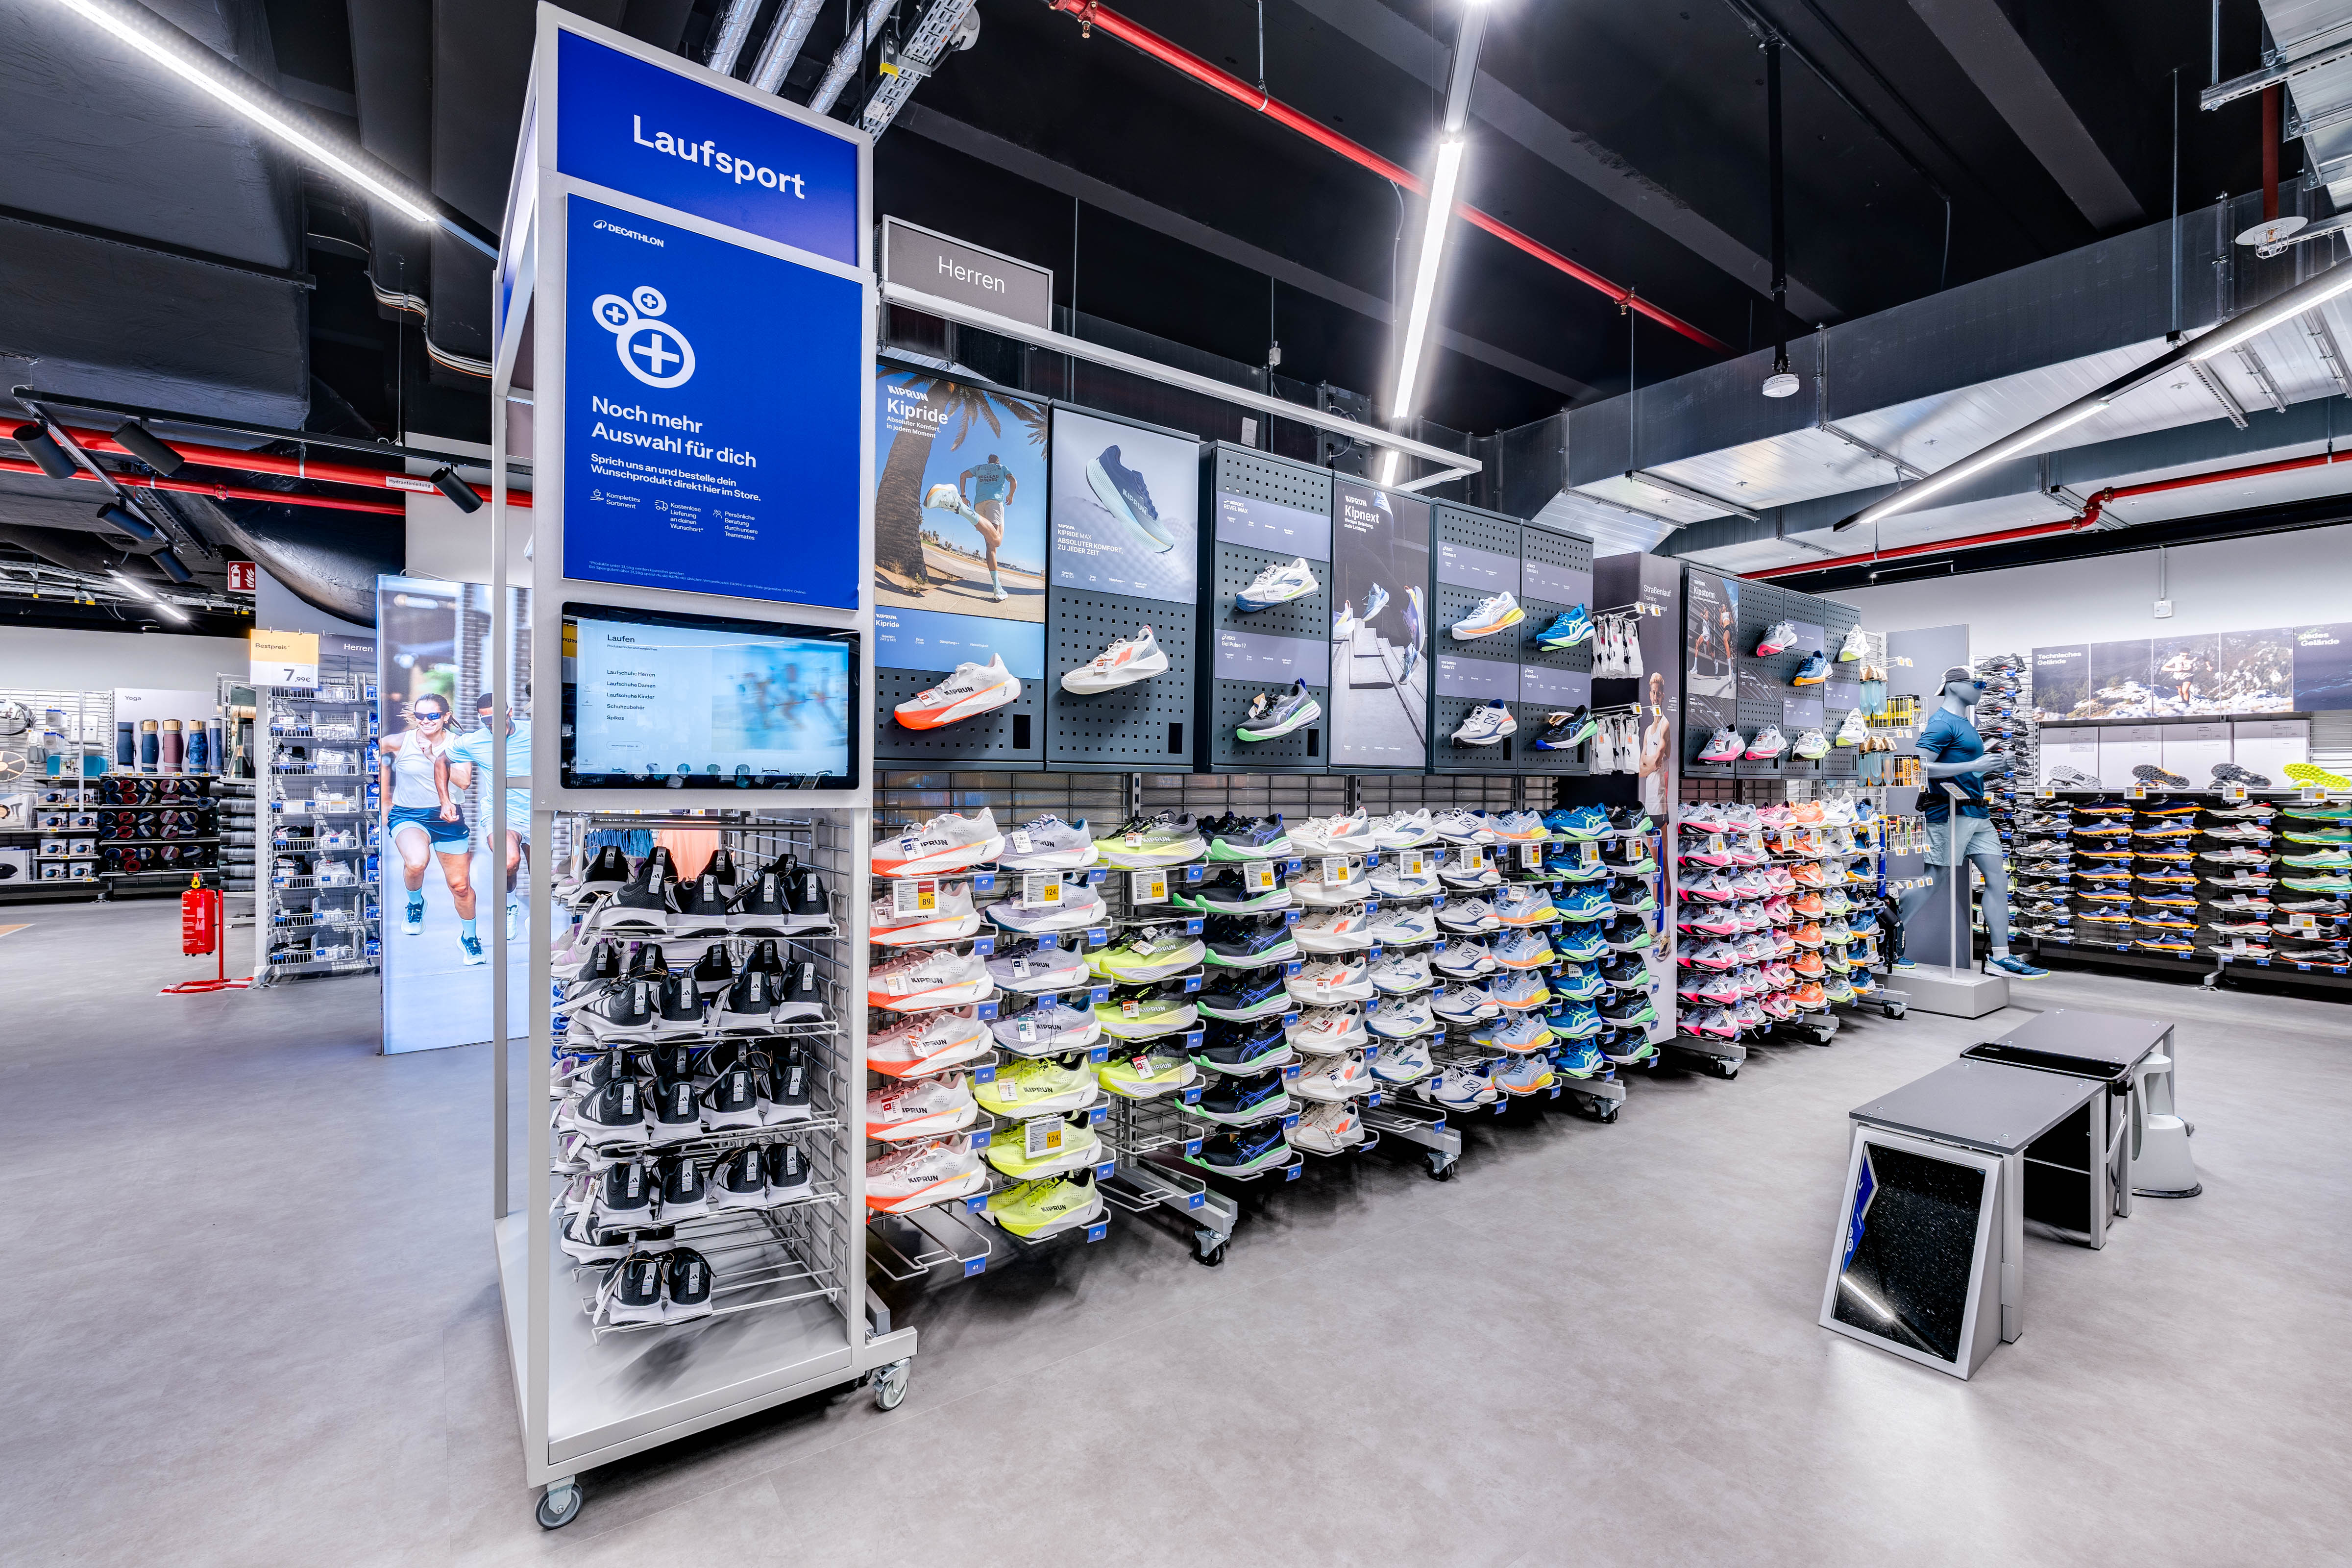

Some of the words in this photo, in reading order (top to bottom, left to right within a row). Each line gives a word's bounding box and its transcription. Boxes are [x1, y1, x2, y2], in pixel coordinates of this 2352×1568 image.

[634, 115, 805, 199] Laufsport
[608, 222, 663, 247] DECATHLON
[939, 256, 1004, 293] Herren
[887, 385, 929, 401] KIPRUN
[593, 396, 647, 422] Noch
[652, 413, 703, 433] mehr
[888, 398, 948, 424] Kipride
[887, 416, 915, 426] Absoluter
[917, 422, 941, 433] Komfort,
[912, 429, 935, 438] Moment
[591, 422, 681, 453] Auswahl
[685, 441, 713, 459] für
[716, 447, 756, 467] dich
[591, 454, 624, 466] Sprich
[659, 468, 677, 476] und
[679, 469, 715, 483] bestelle
[717, 477, 736, 487] dein
[591, 464, 672, 486] Wunschprodukt
[674, 480, 702, 491] direkt
[703, 484, 721, 494] hier
[722, 488, 733, 496] im
[734, 490, 760, 501] Store.
[607, 492, 640, 502] Komplettes
[1123, 488, 1147, 515] KIPRUN
[1345, 495, 1367, 507] KIPRUN
[607, 499, 636, 509] Sortiment
[671, 503, 701, 512] Kostenlose
[671, 510, 696, 519] Lieferung
[725, 511, 755, 520] Persönliche
[1345, 505, 1379, 524] Kipnext
[725, 518, 749, 527] Beratung
[1345, 518, 1357, 526] Weniger
[725, 531, 755, 540] Teammates
[1058, 529, 1078, 538] KIPRIDE
[1058, 538, 1092, 548] ABSOLUTER
[1094, 543, 1123, 554] KOMFORT,
[1644, 585, 1671, 597] Straßenlauf
[1693, 587, 1715, 599] Kipstorm
[1643, 594, 1657, 603] Training
[344, 643, 372, 652] Herren
[284, 669, 310, 682] 7,99€
[944, 686, 974, 696] KIPRUN
